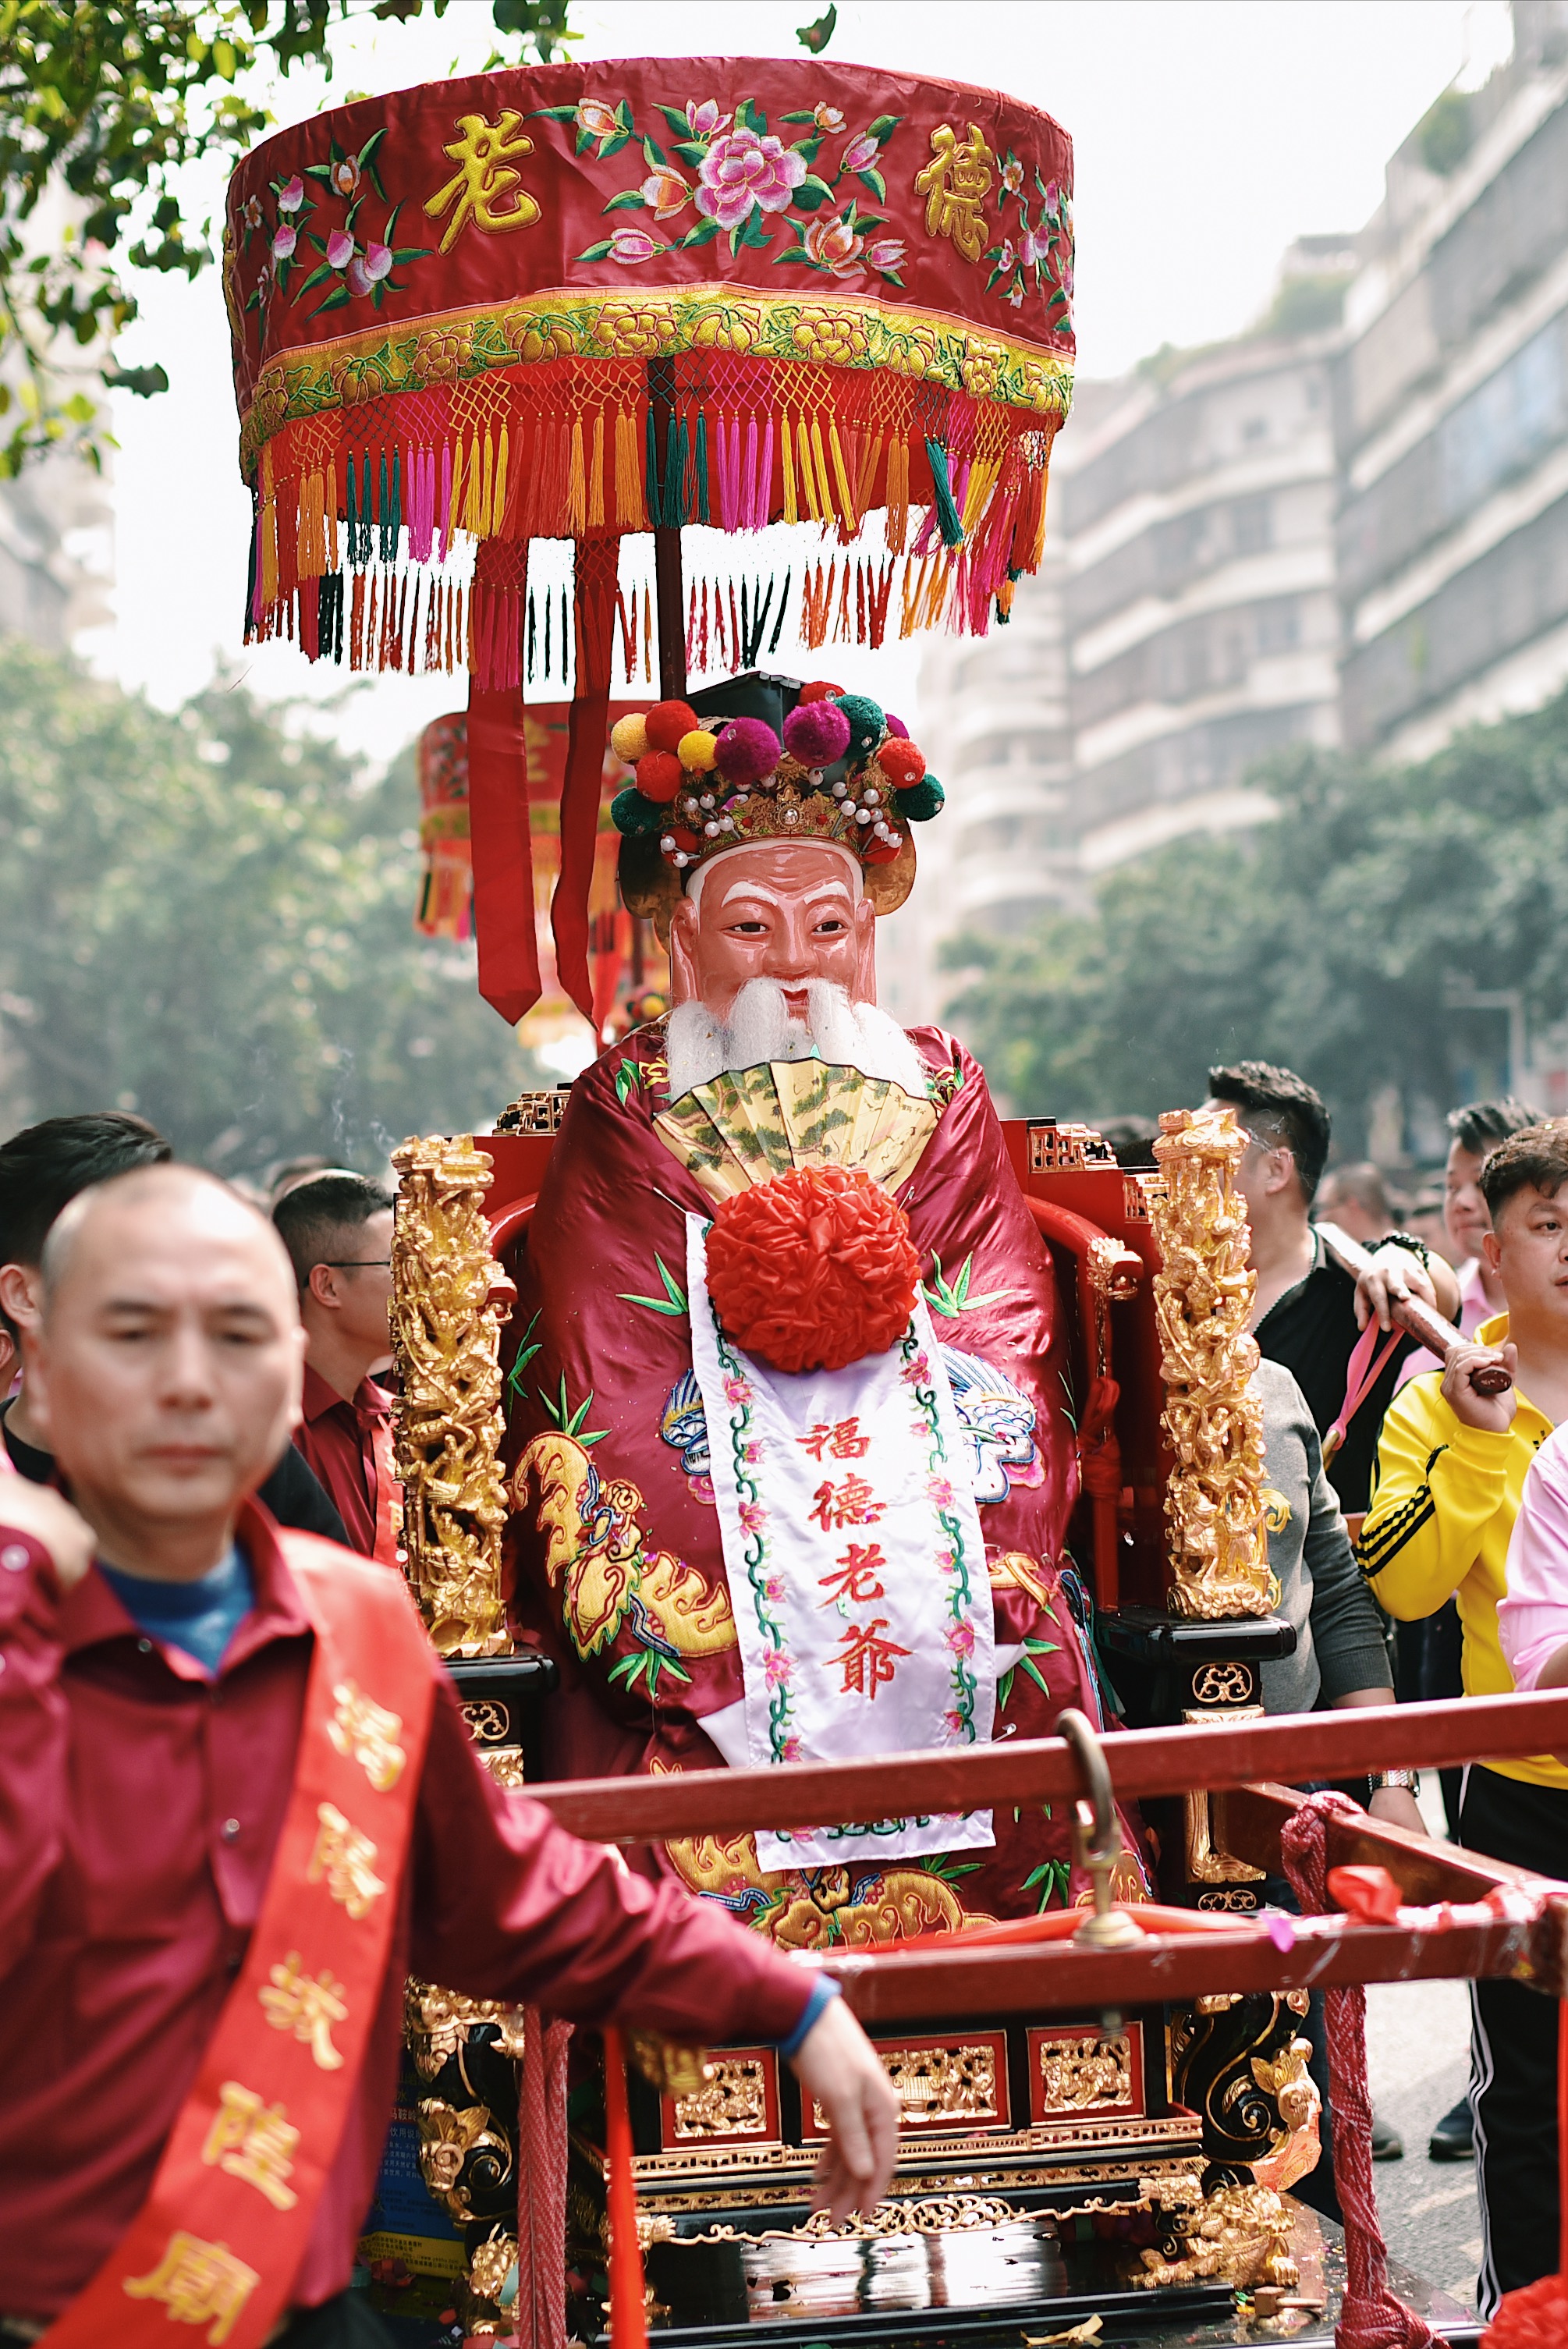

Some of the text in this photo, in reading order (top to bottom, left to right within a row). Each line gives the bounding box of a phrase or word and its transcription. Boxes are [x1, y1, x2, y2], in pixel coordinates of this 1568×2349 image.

[423, 108, 543, 257] 老
[794, 1416, 913, 1701] 福德老爺
